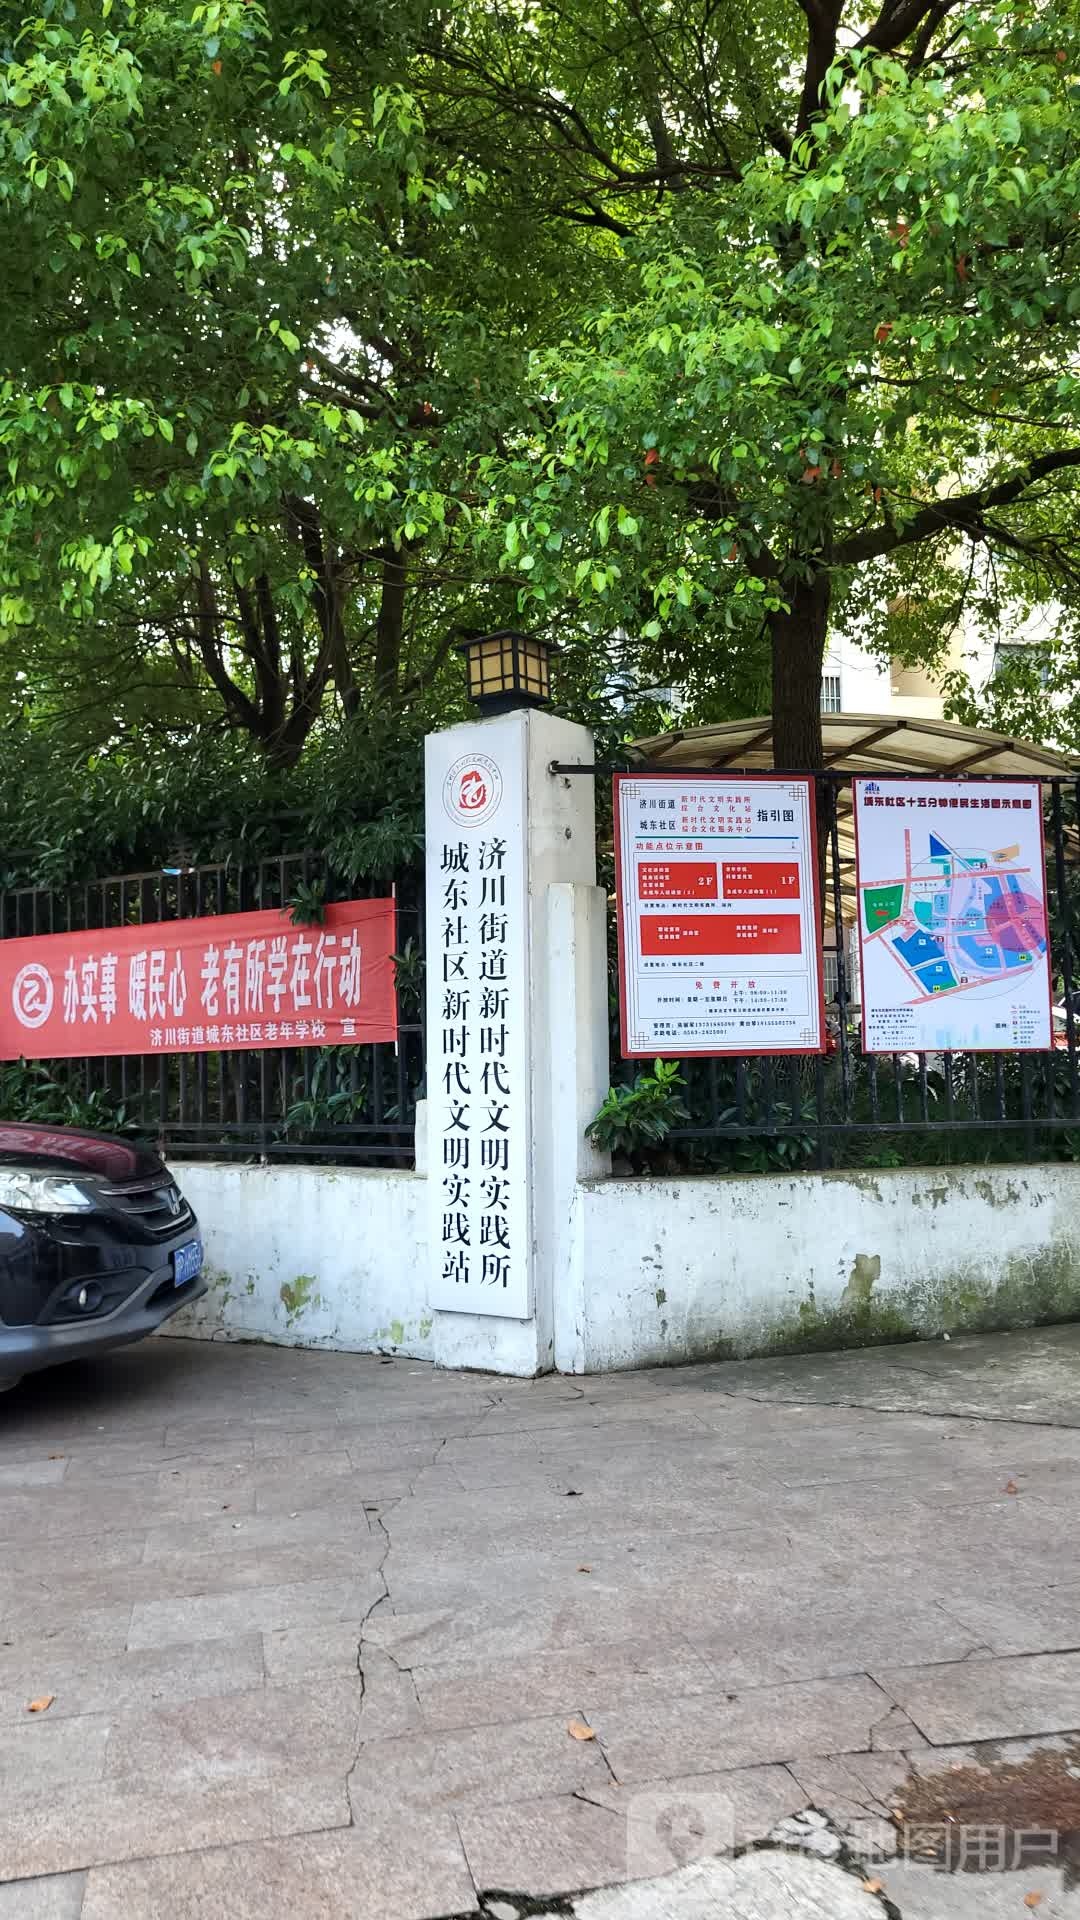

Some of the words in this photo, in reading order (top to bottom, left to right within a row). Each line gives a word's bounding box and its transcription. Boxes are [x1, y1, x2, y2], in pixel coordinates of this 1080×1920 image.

[639, 799, 676, 809] 济川街道
[757, 809, 794, 823] 指引图
[639, 820, 677, 831] 城东社区
[698, 876, 714, 886] 2F
[780, 876, 796, 885] 1F
[62, 952, 119, 1025] 办实事
[128, 949, 187, 1022] 暖民心
[199, 927, 363, 1017] 老有所学在行动
[695, 981, 756, 989] 免费开放
[150, 1019, 327, 1048] 济川街道城东社区老年学校
[341, 1018, 357, 1038] 宣
[440, 841, 472, 1285] 城东社区新时代文明实践站
[478, 837, 512, 1289] 济川街道新时代文明实践所
